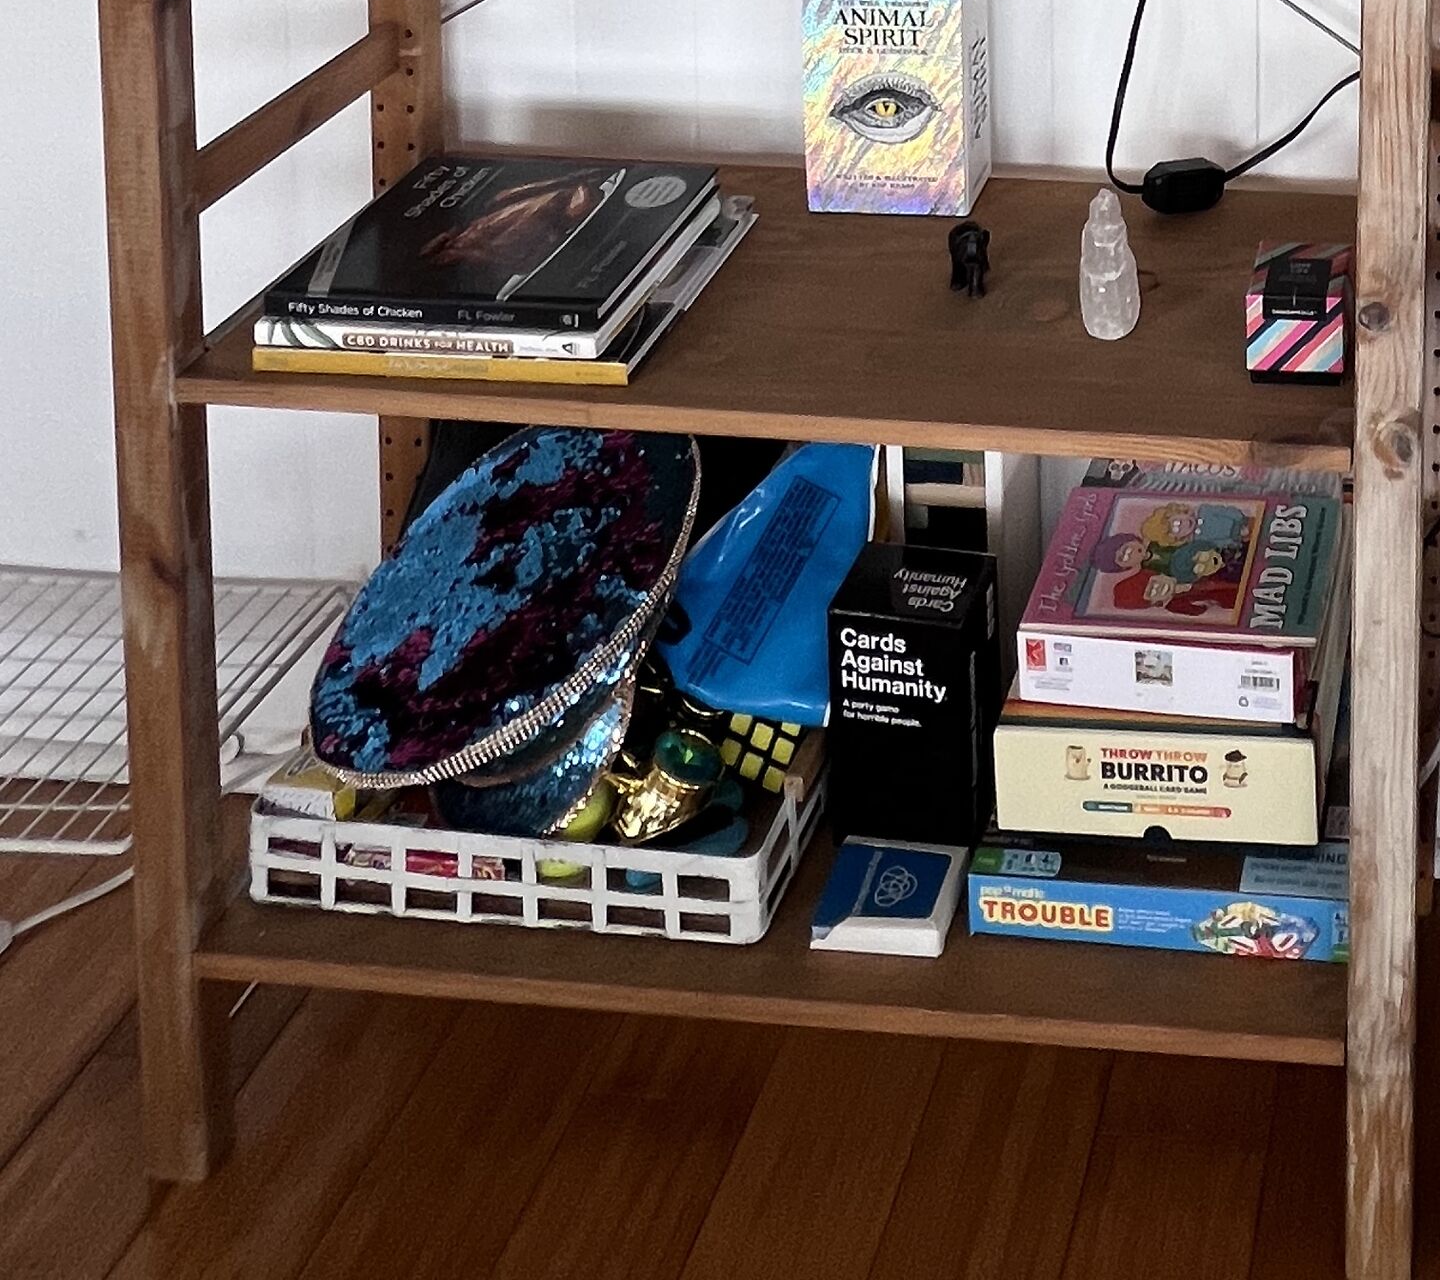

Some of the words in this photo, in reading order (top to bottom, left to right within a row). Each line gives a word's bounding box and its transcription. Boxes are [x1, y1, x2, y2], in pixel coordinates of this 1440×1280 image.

[833, 8, 927, 27] ANIMAL
[844, 28, 922, 47] SPIRIT
[288, 302, 314, 315] Fifty
[318, 303, 359, 316] Shades
[362, 305, 374, 316] of
[378, 306, 423, 318] Chicken
[457, 309, 472, 320] FL
[476, 310, 516, 322] Fowler
[346, 335, 375, 347] CBD
[379, 336, 431, 349] DRINKS
[456, 340, 509, 353] HEALTH
[1264, 504, 1308, 561] LIBS
[893, 567, 968, 589] Humanity
[902, 583, 962, 600] Against
[1039, 581, 1066, 613] The
[1250, 567, 1294, 630] MAD
[908, 596, 954, 613] Cards
[840, 627, 906, 654] Cards
[841, 649, 925, 677] Against
[841, 669, 947, 703] Humanity
[842, 699, 850, 707] A
[851, 701, 874, 711] party
[875, 704, 900, 713] game
[843, 709, 855, 718] for
[1101, 747, 1152, 760] THROW
[1155, 750, 1208, 763] THROW
[1101, 761, 1208, 784] BURRITO
[982, 898, 1112, 929] TROUBLE
